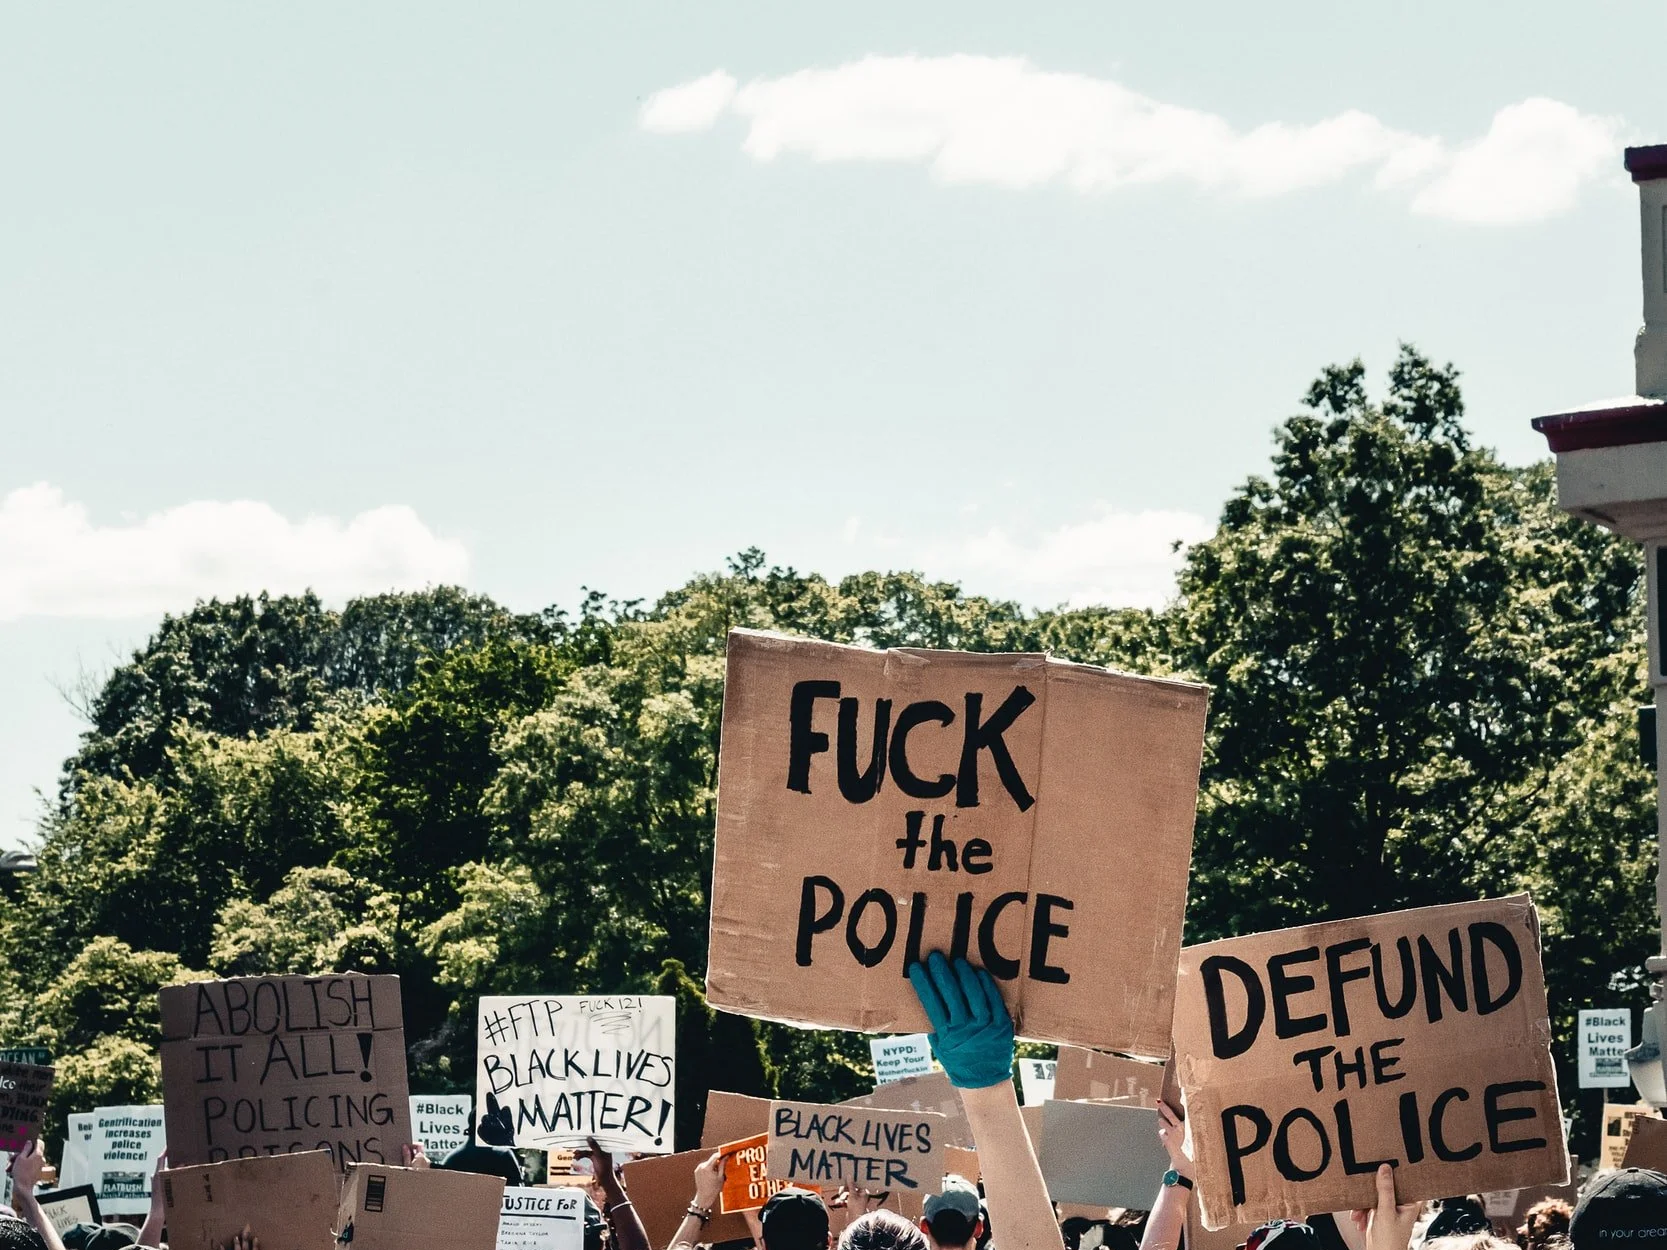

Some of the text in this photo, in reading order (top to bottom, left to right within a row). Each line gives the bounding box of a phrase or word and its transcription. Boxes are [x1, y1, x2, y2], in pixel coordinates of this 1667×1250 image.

[786, 679, 1037, 812] FUCK
[896, 810, 994, 875] the
[795, 875, 1074, 985] POLICE
[193, 978, 376, 1038] ABOLISH
[1199, 921, 1523, 1060] DEFUND
[484, 1000, 563, 1046] #FTP
[579, 998, 614, 1014] FUCK
[618, 997, 643, 1013] 12!
[1585, 1016, 1626, 1027] #Black
[1588, 1033, 1624, 1044] Lives
[196, 1033, 373, 1086] IT ALL!
[484, 1048, 673, 1095] BLACK LIVES
[877, 1059, 901, 1067] Keep
[883, 1046, 917, 1056] NYPD:
[1293, 1038, 1408, 1093] THE
[98, 1118, 162, 1128] Gentrification
[203, 1093, 395, 1146] POLICING
[416, 1103, 465, 1115] #Black
[419, 1120, 461, 1135] Lives
[516, 1090, 674, 1146] MATTER!
[775, 1108, 932, 1154] BLACK LIVES
[103, 1151, 148, 1161] violence!
[105, 1129, 152, 1139] increases
[111, 1140, 142, 1150] police
[1221, 1080, 1547, 1207] POLICE
[788, 1148, 919, 1189] MATTER
[1611, 1229, 1634, 1240] your
